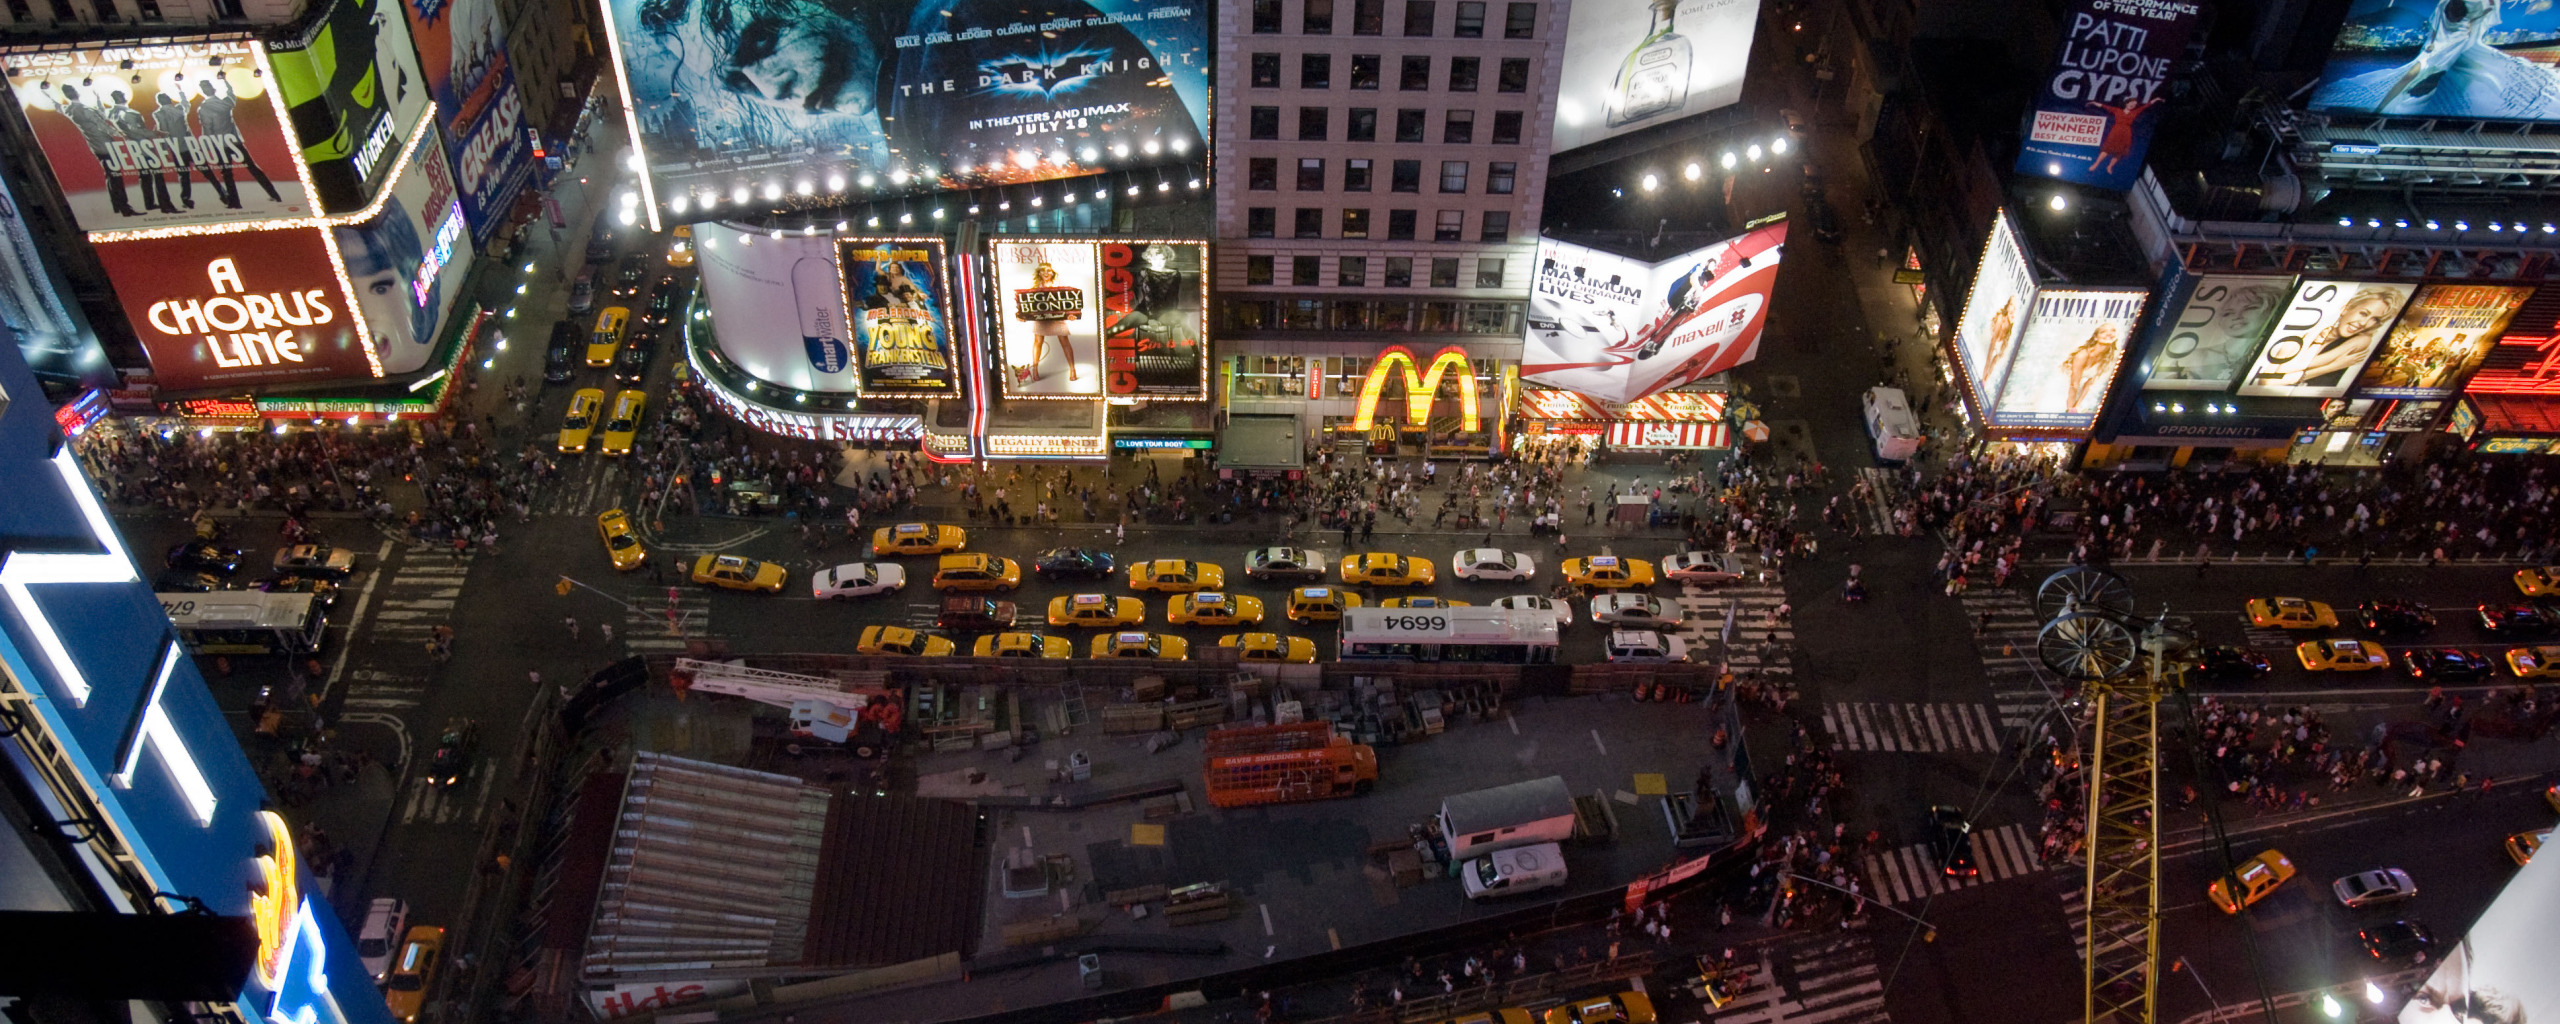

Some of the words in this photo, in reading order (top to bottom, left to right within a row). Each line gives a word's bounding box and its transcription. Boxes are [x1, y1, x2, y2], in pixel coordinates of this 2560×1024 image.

[1706, 2, 1714, 10] IS
[2093, 1, 2110, 10] OF
[2114, 3, 2137, 15] THE
[2140, 7, 2177, 21] YEAR!
[2107, 0, 2199, 15] ERFORMANCE
[895, 38, 920, 48] BALE
[925, 34, 953, 45] CAINE
[956, 29, 992, 41] LEDGER
[996, 24, 1036, 36] OLDMAN
[1040, 19, 1082, 31] ECKHART
[1086, 13, 1143, 27] GYLLENHAAL
[1147, 8, 1191, 20] FREEMAN
[2071, 12, 2148, 52] PATTI
[4, 50, 89, 69] BEST
[102, 42, 250, 63] MUSICAL
[21, 65, 73, 78] 2006
[76, 63, 118, 75] Tony
[124, 58, 181, 71] ward
[184, 55, 244, 68] Winer
[2061, 41, 2170, 79] LUPONE
[900, 79, 955, 97] THE
[978, 66, 1057, 88] DARK
[1080, 52, 1193, 77] KNIGHT
[2052, 69, 2162, 104] GYPSY
[969, 119, 983, 131] IN
[985, 112, 1050, 128] THEATERS
[1054, 107, 1080, 119] AND
[1083, 102, 1130, 116] IMAX
[1015, 117, 1062, 137] JULY
[1065, 117, 1089, 131] 18
[2038, 120, 2101, 135] WINNER!
[2039, 113, 2067, 122] TONY
[2069, 115, 2103, 125] AWARD
[460, 84, 522, 195] GREASE
[2034, 132, 2056, 141] BEST
[2058, 134, 2098, 144] ACTRESS
[104, 136, 186, 172] JERSEY
[183, 133, 246, 167] BOYS
[424, 143, 446, 190] BEST
[477, 190, 487, 211] is
[486, 168, 501, 197] the
[421, 169, 453, 234] MUSICAL
[207, 257, 245, 294] A
[1541, 267, 1642, 299] MAXIMUM
[1018, 290, 1081, 303] LEGALLY
[1538, 282, 1596, 305] LIVES
[1540, 275, 1640, 306] PERFORMANCE
[2423, 287, 2531, 310] HEIGHTS
[147, 289, 334, 335] CHORUS
[866, 307, 889, 321] MEL
[1020, 300, 1084, 314] BLONDE
[2037, 297, 2098, 318] MAMMA
[2103, 299, 2141, 319] MIA!
[1671, 319, 1725, 348] maxell
[2151, 285, 2229, 380] TOUS
[2419, 316, 2448, 328] BEST
[2449, 316, 2494, 329] MUSICAL
[815, 306, 840, 372] smartwater
[868, 323, 938, 352] YOUNG
[1137, 337, 1161, 352] Sin
[1166, 339, 1177, 348] is
[1180, 338, 1195, 348] in
[2248, 284, 2339, 386] TOUS
[205, 329, 305, 369] LINE
[865, 348, 948, 369] FRANKENSTEIN
[206, 402, 253, 416] STEAKS
[265, 401, 307, 412] sbarro
[325, 401, 366, 413] sbarro
[383, 402, 426, 414] sbarro
[744, 408, 821, 442] GUEST
[832, 420, 918, 442] SUITES
[1528, 424, 1543, 433] 47
[2158, 426, 2262, 436] OPPORTUNITY
[994, 438, 1045, 447] LEGALLY
[1048, 438, 1099, 448] BLONDE
[1126, 440, 1149, 448] LOVE
[1150, 440, 1164, 448] YOUR
[1165, 440, 1184, 449] BODY
[1384, 615, 1446, 631] 6694
[601, 979, 705, 1020] tkts
